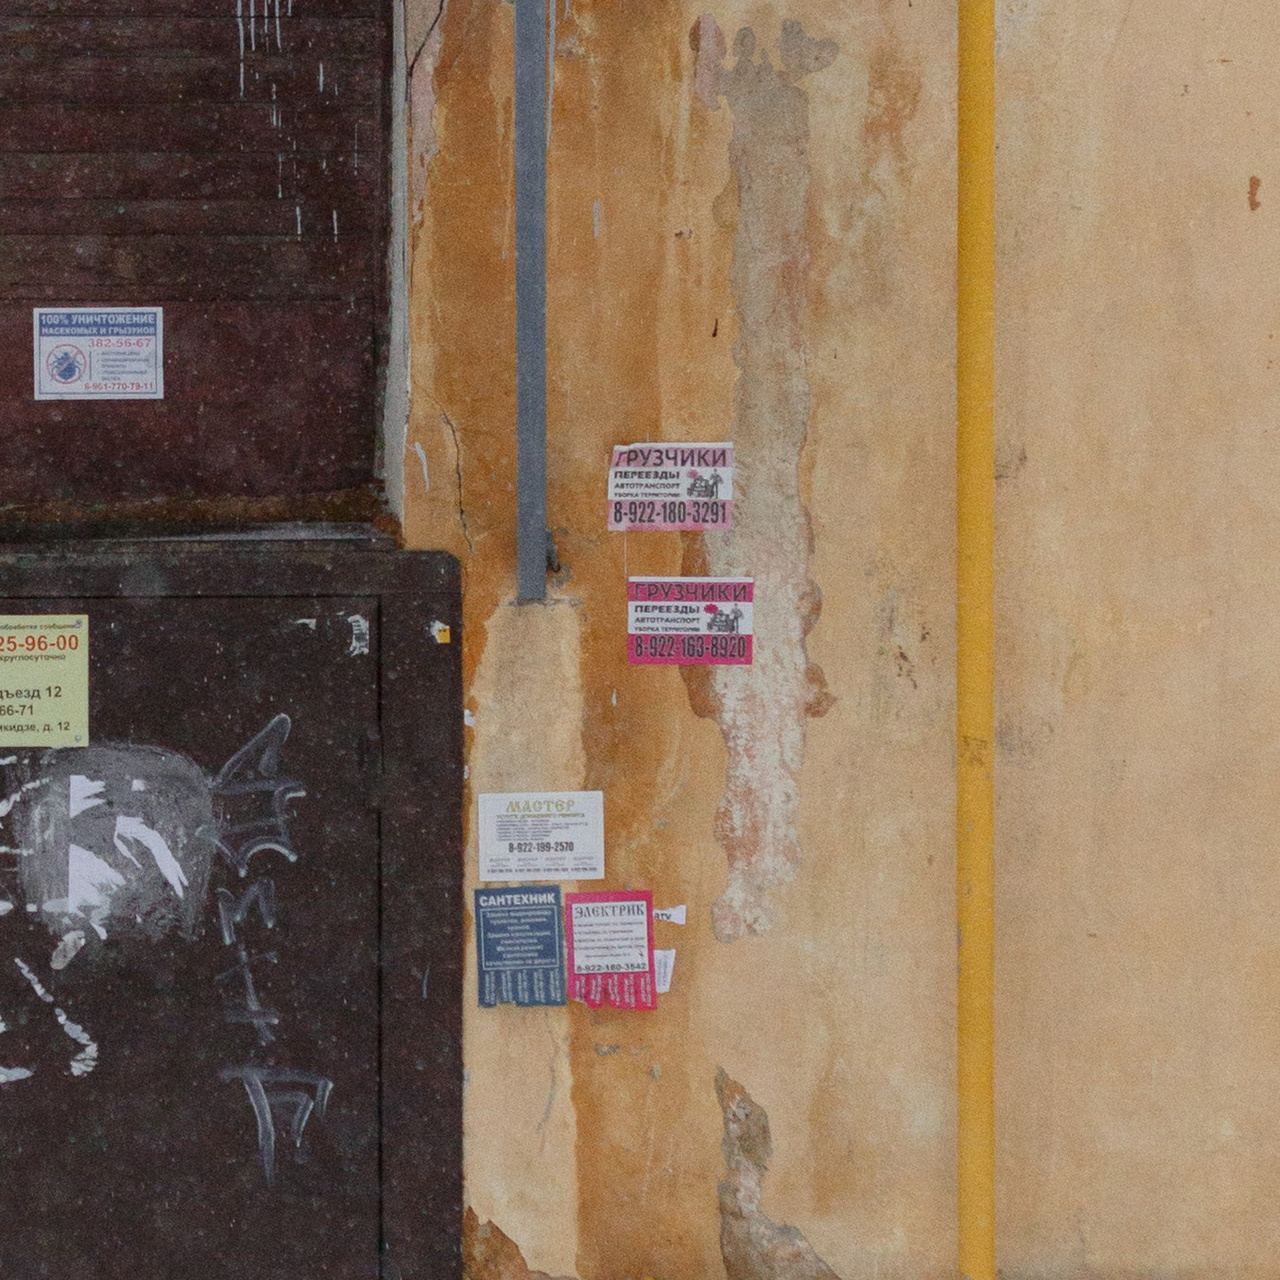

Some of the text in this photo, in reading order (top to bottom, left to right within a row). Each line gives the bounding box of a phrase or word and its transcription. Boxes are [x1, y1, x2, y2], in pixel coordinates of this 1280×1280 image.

[40, 313, 155, 325] 100% УНИЧТОЖЕНИЕ
[41, 327, 98, 335] НАСЕКОМЫХ
[108, 326, 155, 334] ГРЫЗУНОВ
[615, 449, 727, 467] ГРУЗЧИКИ
[614, 471, 680, 480] ПЕРЕЕЗДЫ
[614, 501, 726, 523] 8-922-180-3291
[635, 583, 747, 602] ГРУЗЧИКИ
[634, 605, 700, 614] ПЕРЕЕЗДЫ
[634, 635, 746, 658] 8-922-163-8920
[46, 686, 62, 698] 12
[42, 723, 53, 732] д.
[57, 722, 70, 731] 12
[506, 800, 576, 813] МАСТЕР
[480, 892, 556, 907] САНТЕХНИК
[574, 904, 646, 919] ЭЛЕКТРИК
